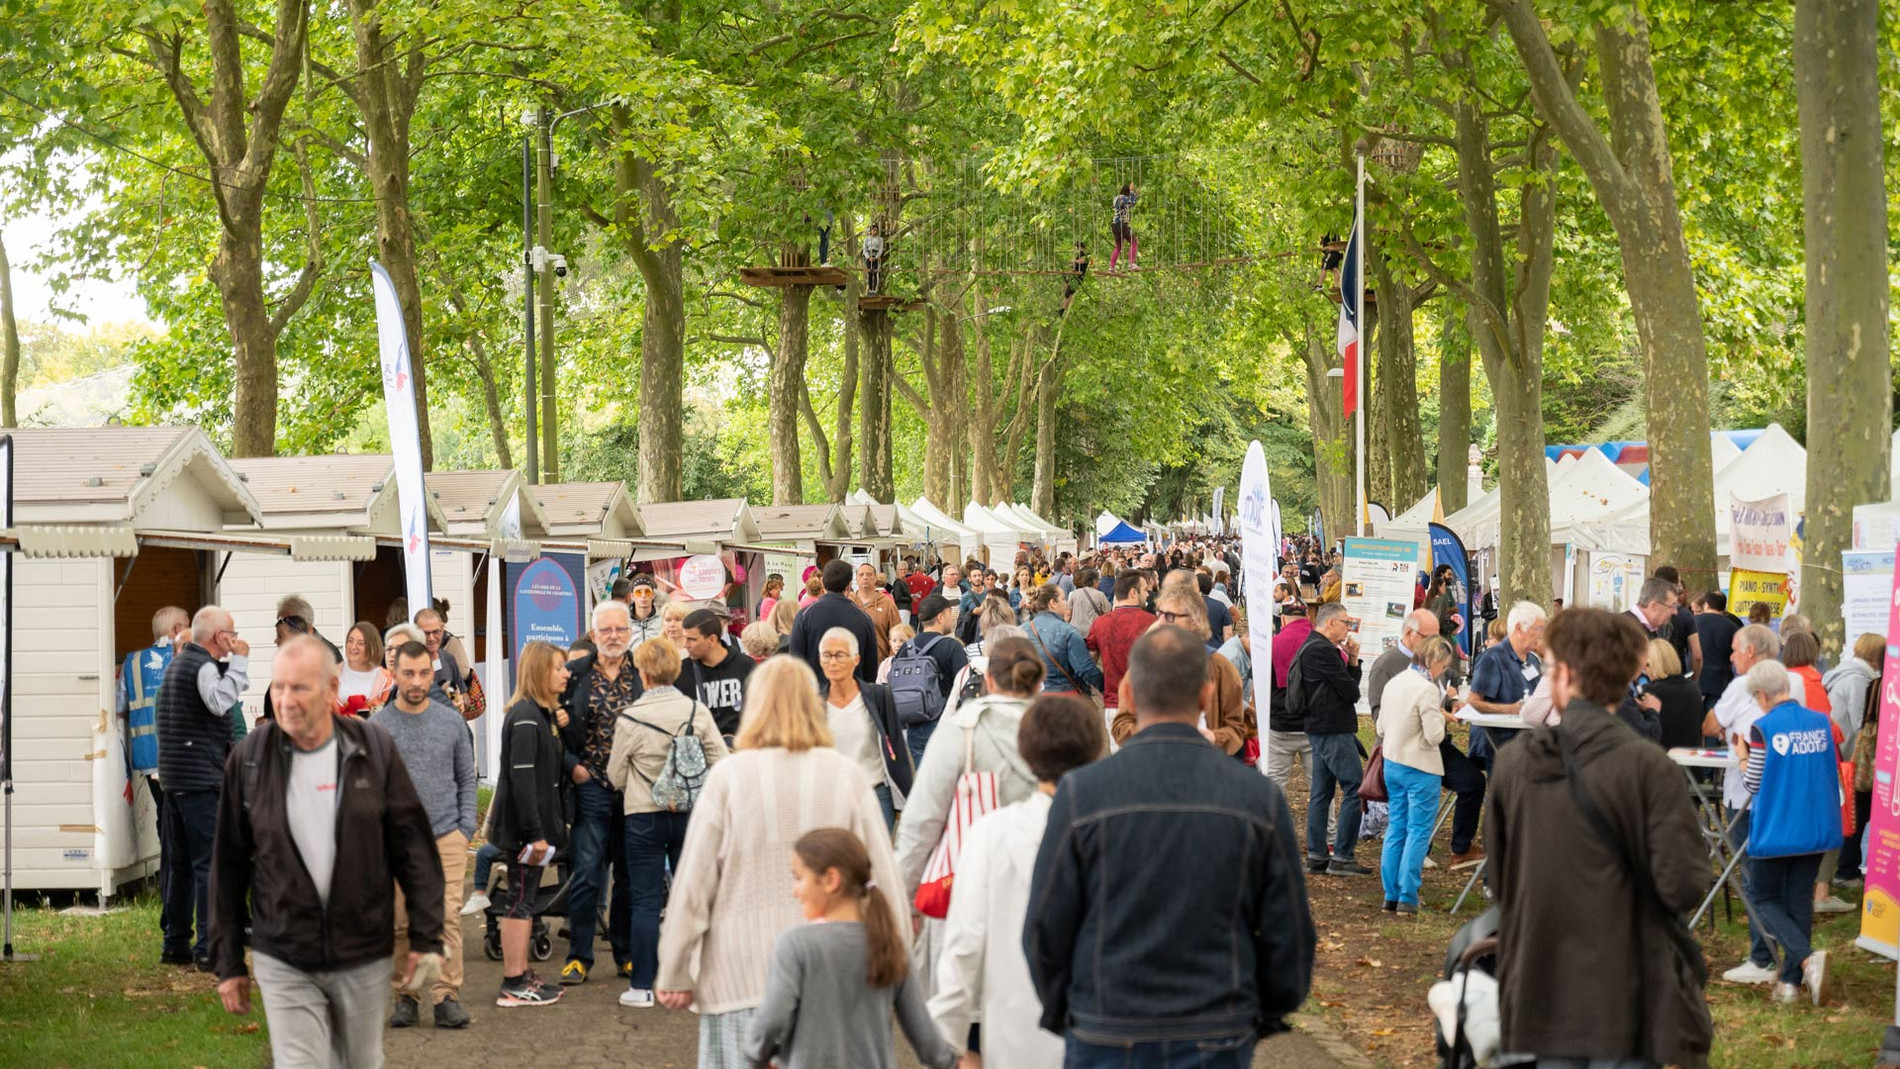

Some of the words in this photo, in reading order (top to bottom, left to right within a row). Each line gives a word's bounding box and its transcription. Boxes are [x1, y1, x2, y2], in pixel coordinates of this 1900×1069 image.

[1739, 581, 1757, 592] PIANO
[531, 623, 565, 633] Ensemble,
[526, 634, 563, 643] participons
[1789, 730, 1826, 742] FRANCE
[1792, 740, 1820, 755] ADOT
